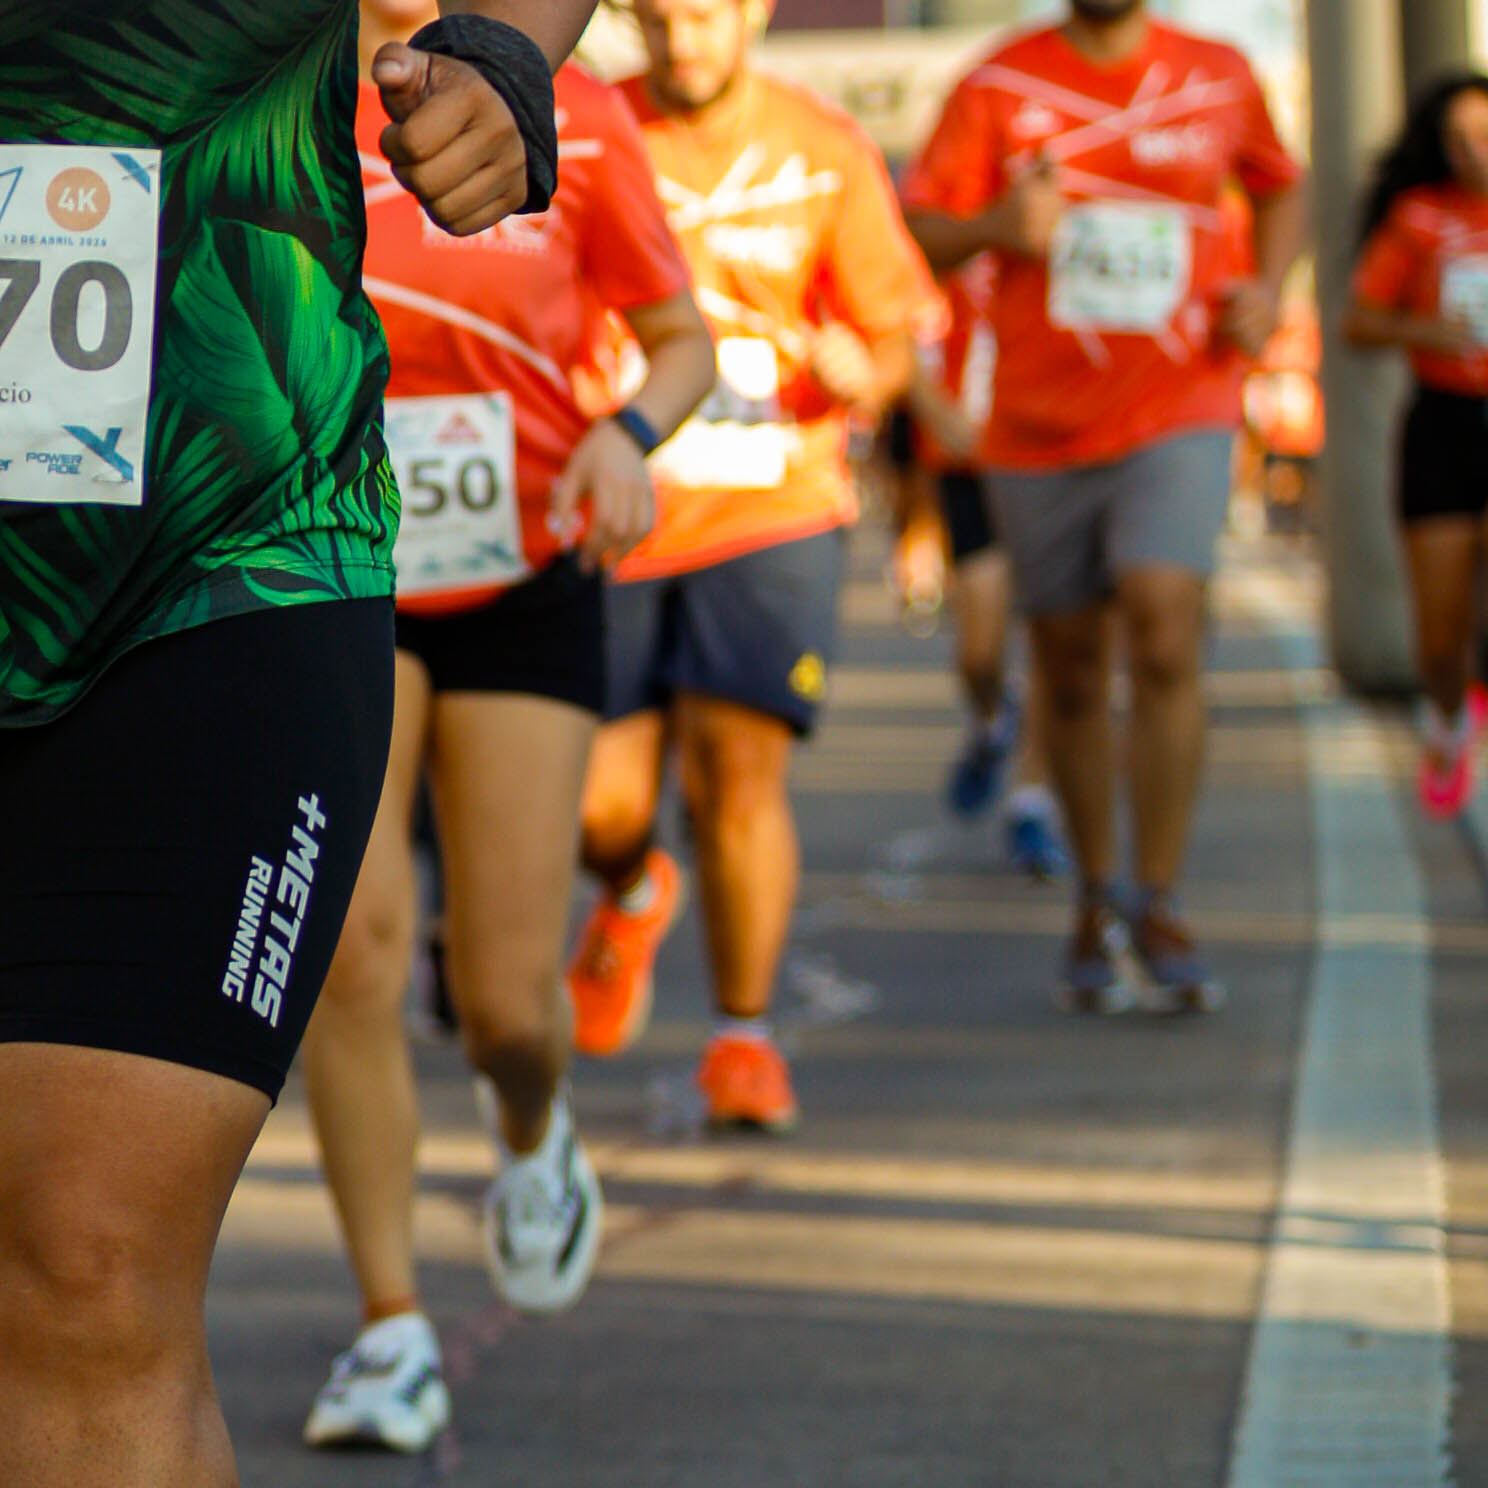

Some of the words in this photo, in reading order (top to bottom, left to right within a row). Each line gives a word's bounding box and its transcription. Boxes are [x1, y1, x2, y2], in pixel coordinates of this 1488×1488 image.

[57, 187, 97, 212] 4K
[20, 234, 36, 245] DE
[40, 235, 74, 246] ABRIL
[26, 452, 82, 464] POWER
[222, 855, 273, 1002] RUNNING
